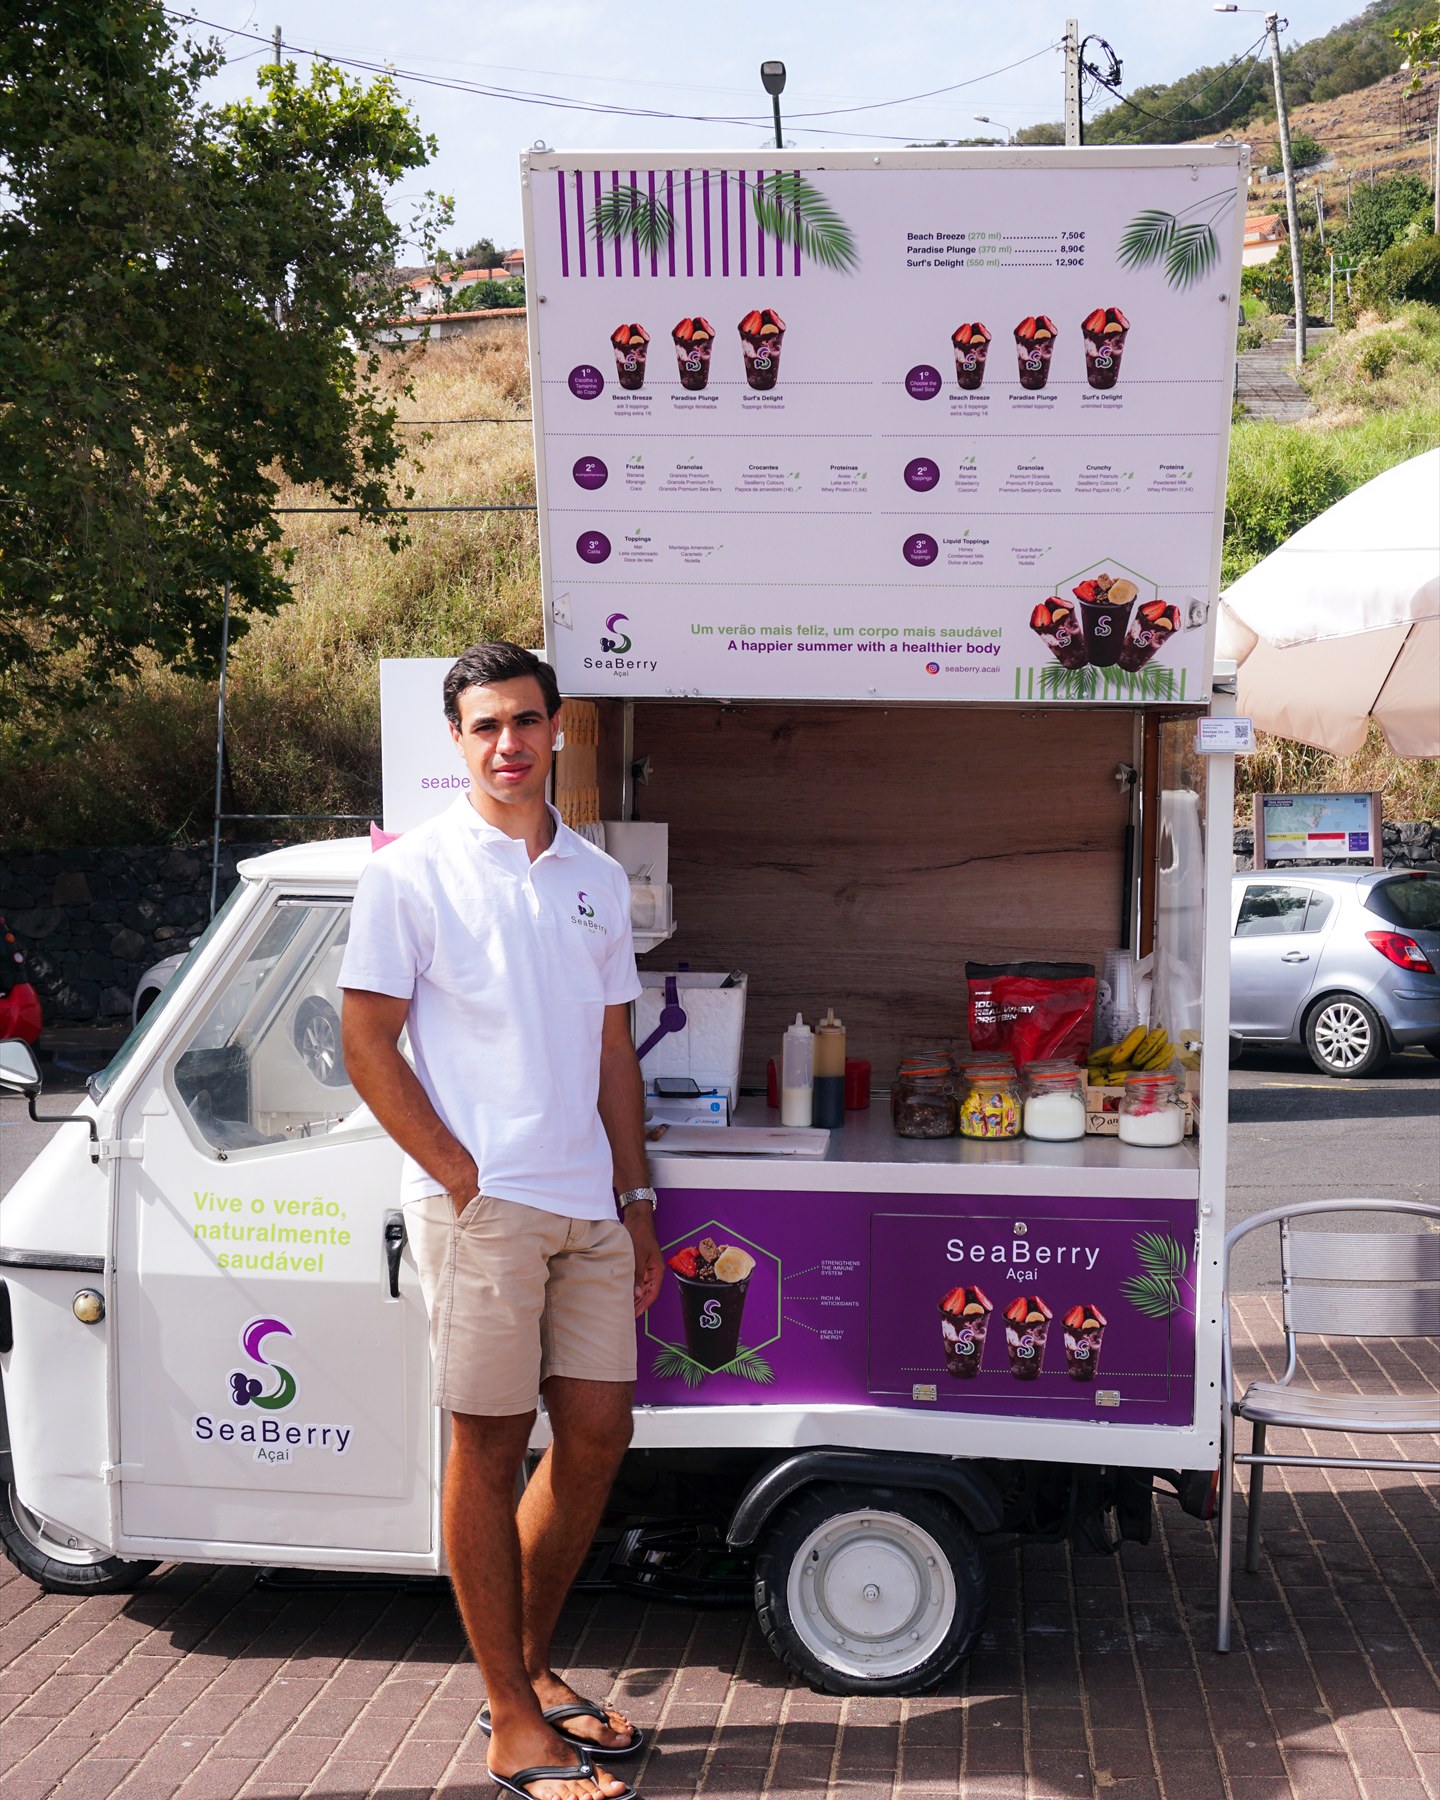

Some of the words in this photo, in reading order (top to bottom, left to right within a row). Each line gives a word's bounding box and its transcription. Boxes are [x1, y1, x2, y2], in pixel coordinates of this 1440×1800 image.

[907, 232, 934, 241] Beach
[936, 232, 966, 240] Breeze
[967, 232, 986, 241] (270
[988, 232, 1002, 241] ml)
[1061, 231, 1086, 240] 7,50€
[907, 246, 944, 254] Paradise
[946, 245, 976, 255] Plunge
[978, 245, 997, 254] (370
[999, 245, 1012, 254] ml)
[1060, 244, 1085, 253] 8,90€
[906, 259, 932, 267] Surf's
[934, 259, 964, 269] Delight
[966, 259, 984, 267] (550
[986, 259, 1000, 267] ml)
[1056, 258, 1084, 267] 12,90€
[690, 623, 714, 635] Um
[717, 623, 756, 636] verão
[760, 624, 793, 636] mais
[796, 624, 829, 638] feliz,
[833, 627, 855, 636] um
[858, 627, 900, 640] corpo
[903, 625, 936, 638] mais
[939, 626, 1002, 638] saudável
[727, 639, 738, 651] A
[741, 639, 794, 654] happier
[796, 642, 854, 652] summer
[856, 640, 886, 652] with
[889, 643, 898, 653] a
[902, 641, 963, 654] healthier
[966, 642, 1001, 657] body
[583, 657, 658, 673] SeaBerry
[944, 665, 1001, 674] seaberry.acaii
[613, 670, 629, 678] Açaí
[421, 774, 470, 789] seabe
[570, 915, 608, 935] SeaBerry
[974, 1008, 1001, 1016] REAL
[975, 1014, 1018, 1024] PROTEIN
[193, 1190, 243, 1214] Vive
[250, 1198, 265, 1214] o
[273, 1196, 348, 1222] verão,
[193, 1221, 351, 1246] naturalmente
[216, 1250, 324, 1273] saudável
[946, 1238, 1100, 1271] SeaBerry
[1006, 1267, 1038, 1283] Açaí
[195, 1416, 351, 1454] SeaBerry
[256, 1446, 290, 1463] Açaí
